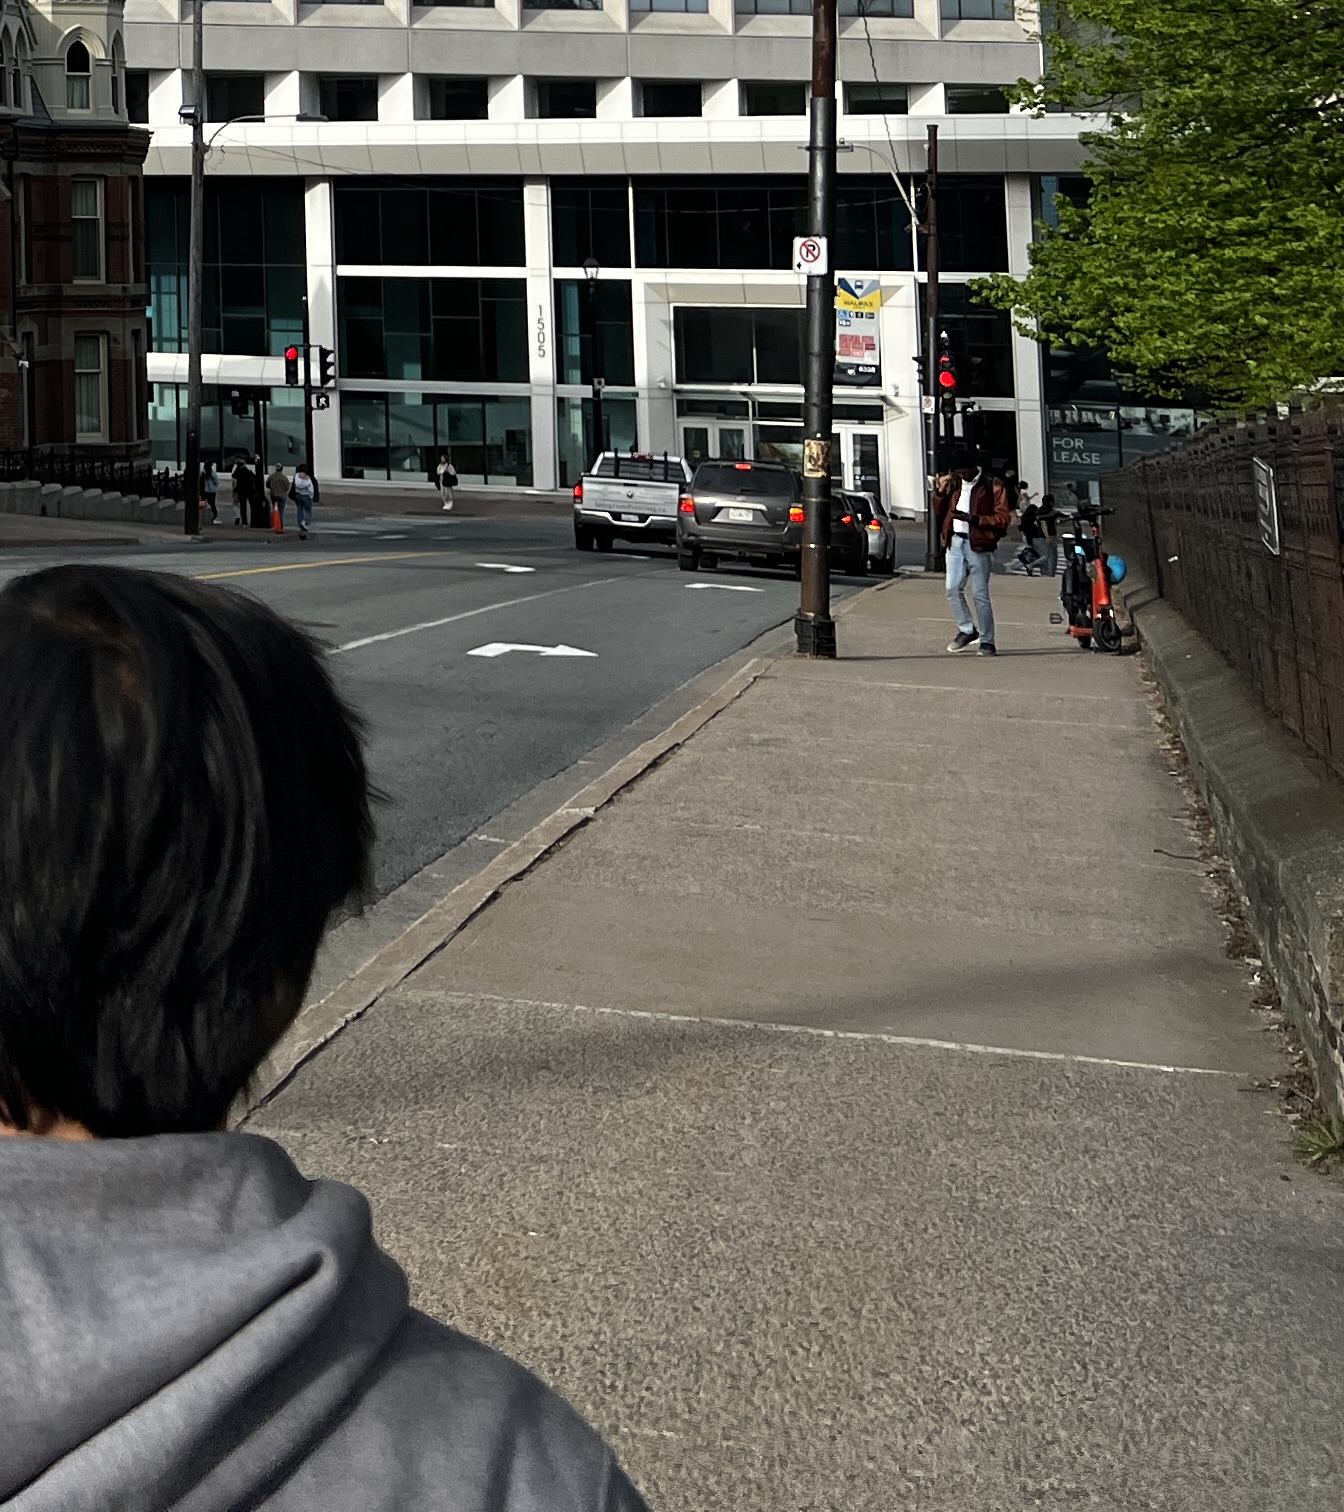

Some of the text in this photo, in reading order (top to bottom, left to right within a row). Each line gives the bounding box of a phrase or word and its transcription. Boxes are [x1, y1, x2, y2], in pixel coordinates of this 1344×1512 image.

[537, 304, 546, 358] 1505
[1052, 437, 1085, 449] FOR
[1053, 451, 1101, 465] LEASE
